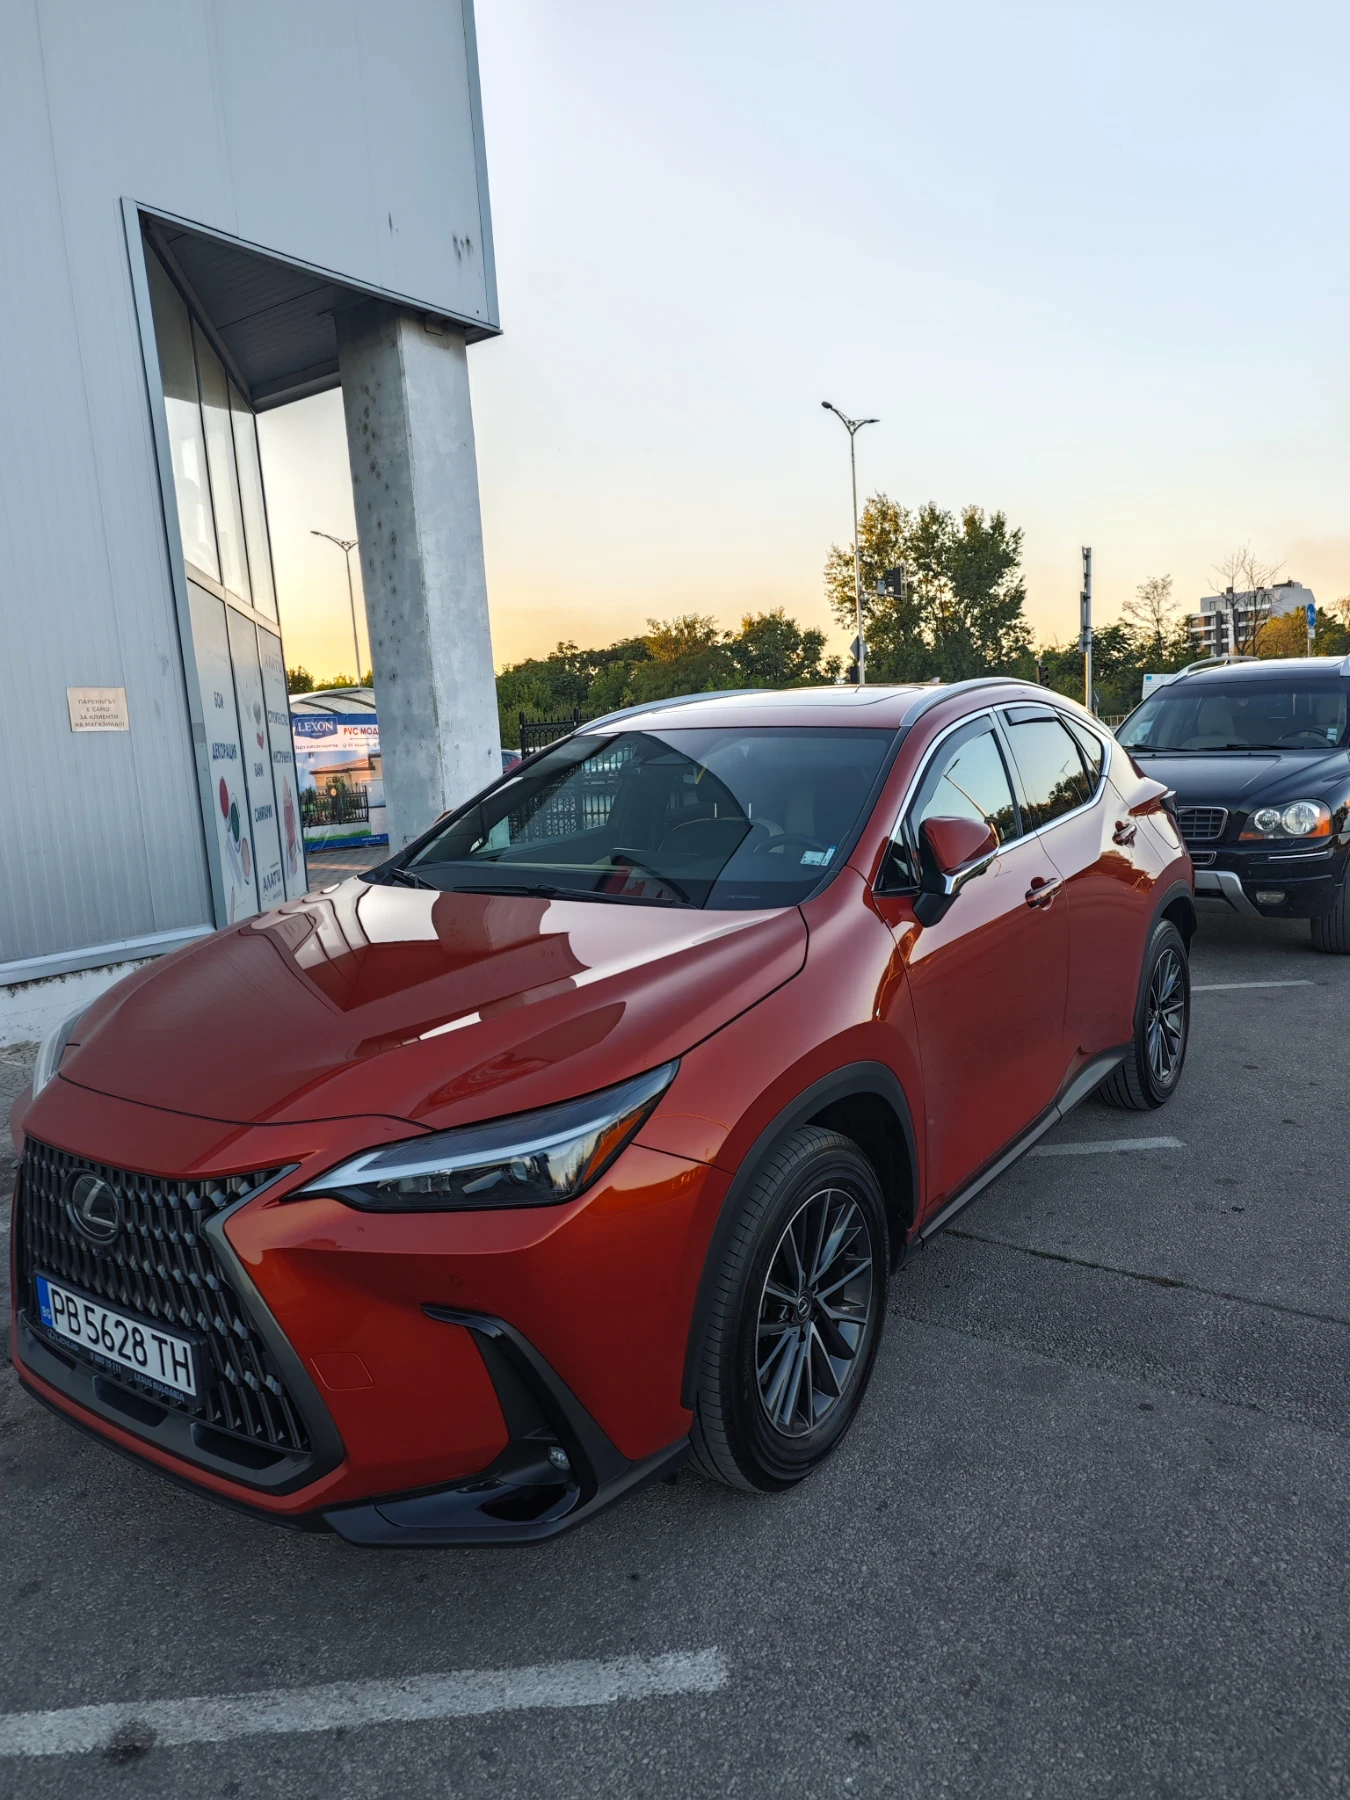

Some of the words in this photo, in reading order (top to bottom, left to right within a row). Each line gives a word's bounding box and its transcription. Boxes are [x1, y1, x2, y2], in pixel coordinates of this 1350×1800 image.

[297, 721, 334, 732] LEXON
[343, 727, 359, 736] PVC
[41, 1305, 52, 1320] BG
[50, 1287, 81, 1336] PB
[83, 1303, 148, 1367] 5628
[151, 1333, 191, 1388] TH
[134, 1372, 152, 1387] LEXUS
[152, 1381, 185, 1401] BULGARIA
